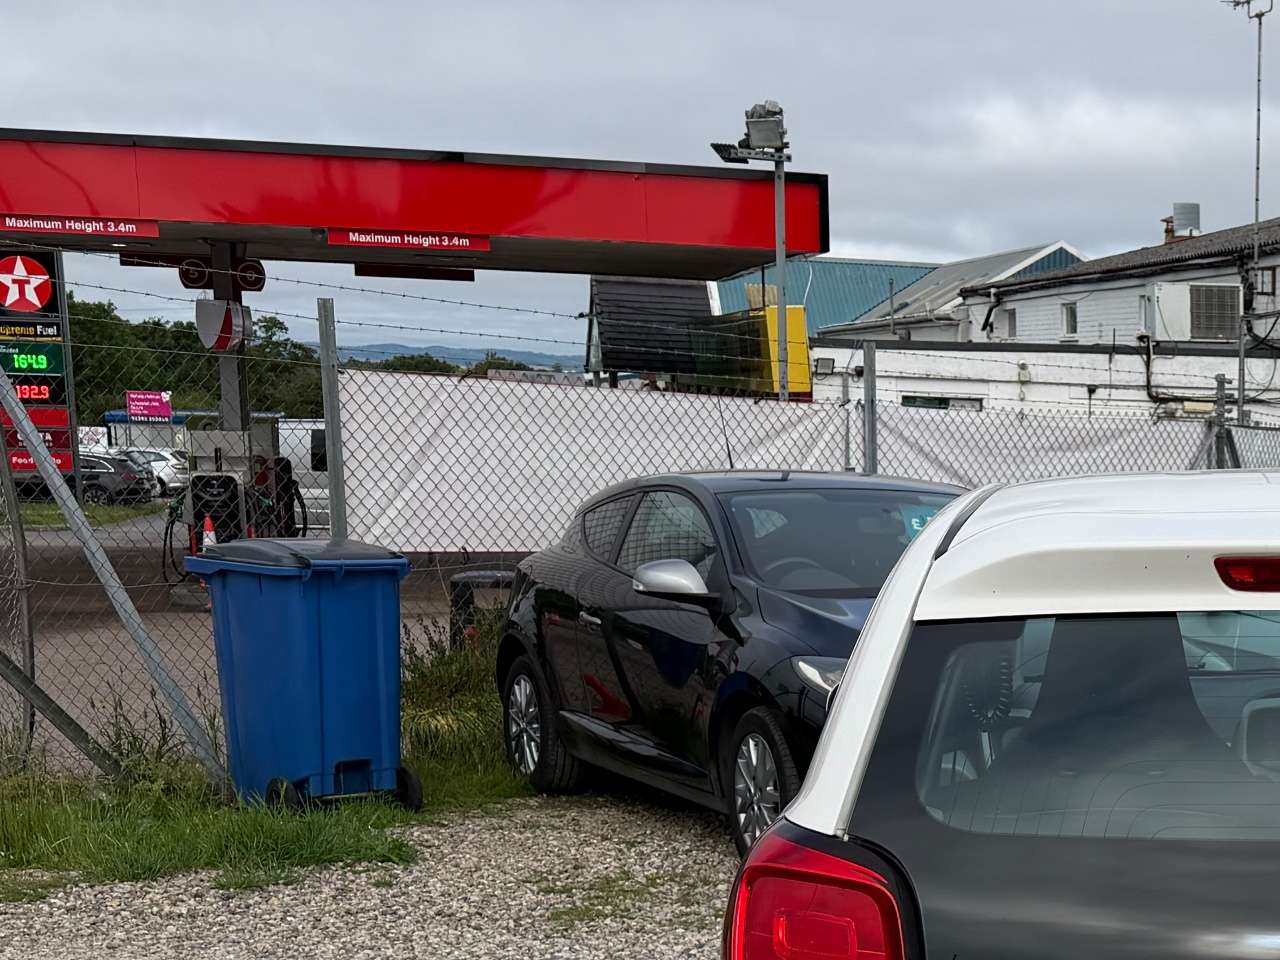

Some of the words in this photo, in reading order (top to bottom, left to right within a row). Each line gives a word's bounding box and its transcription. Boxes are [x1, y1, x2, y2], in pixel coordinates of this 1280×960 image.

[5, 217, 62, 229] Maximum
[65, 220, 104, 233] Height
[107, 221, 137, 233] 3.4m
[349, 232, 401, 244] Maximum
[404, 235, 440, 247] Height
[441, 236, 470, 246] 3.4m
[36, 325, 57, 335] Fuel
